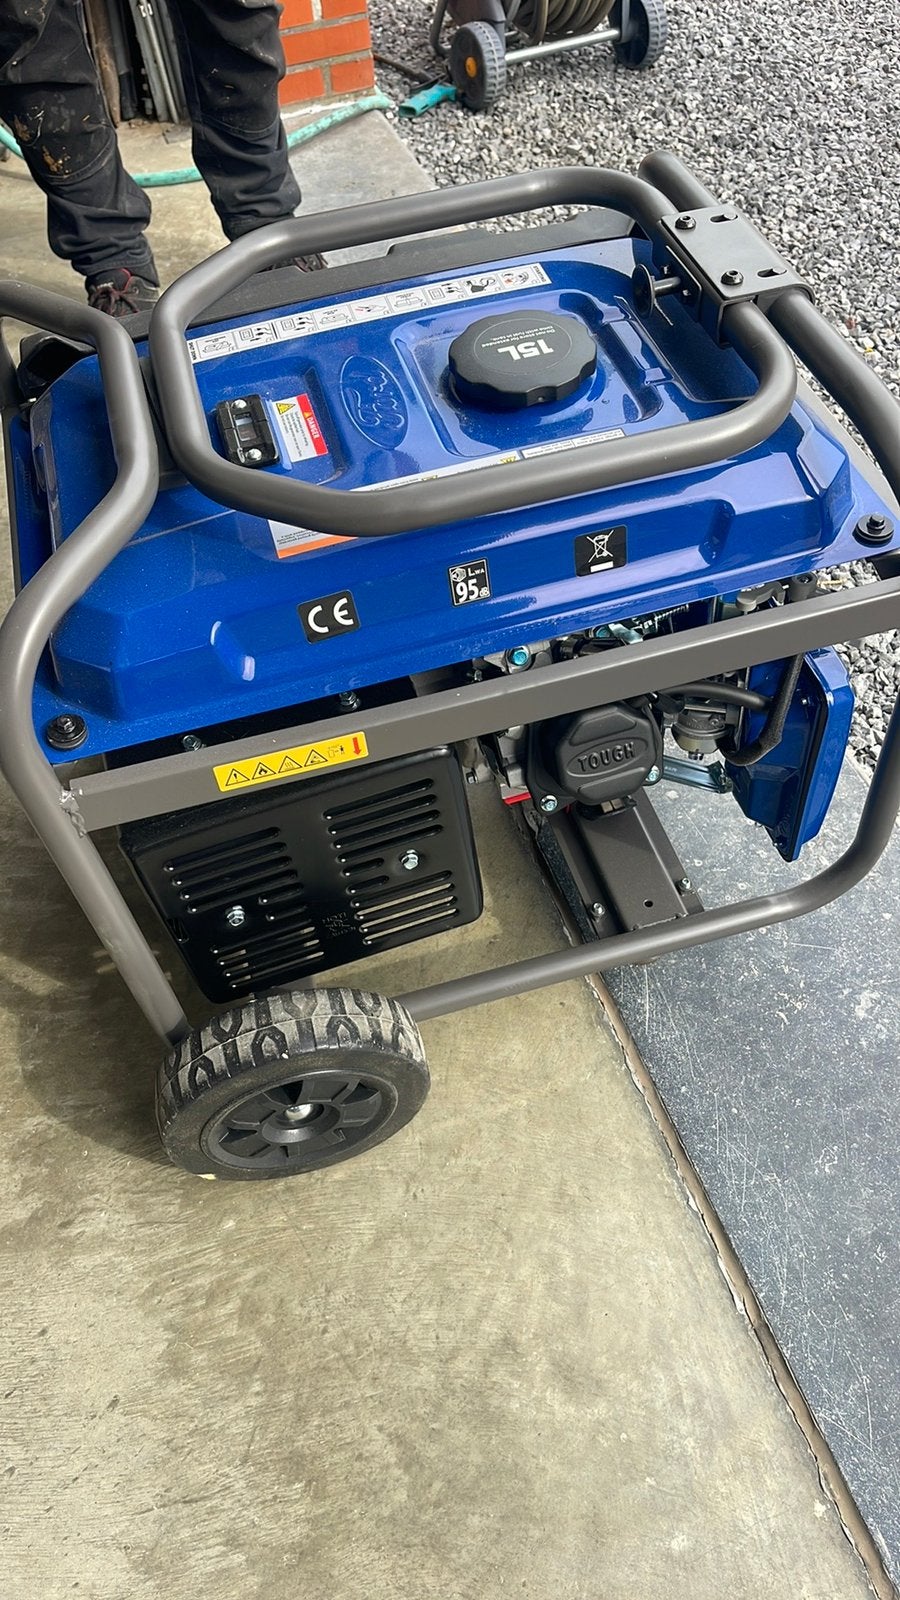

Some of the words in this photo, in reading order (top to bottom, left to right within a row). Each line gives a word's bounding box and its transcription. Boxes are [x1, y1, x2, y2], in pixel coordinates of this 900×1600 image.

[497, 339, 554, 361] 15L
[344, 368, 405, 431] Ford
[306, 416, 320, 439] DANGER
[307, 597, 354, 634] CE
[577, 742, 635, 772] TOUGH
